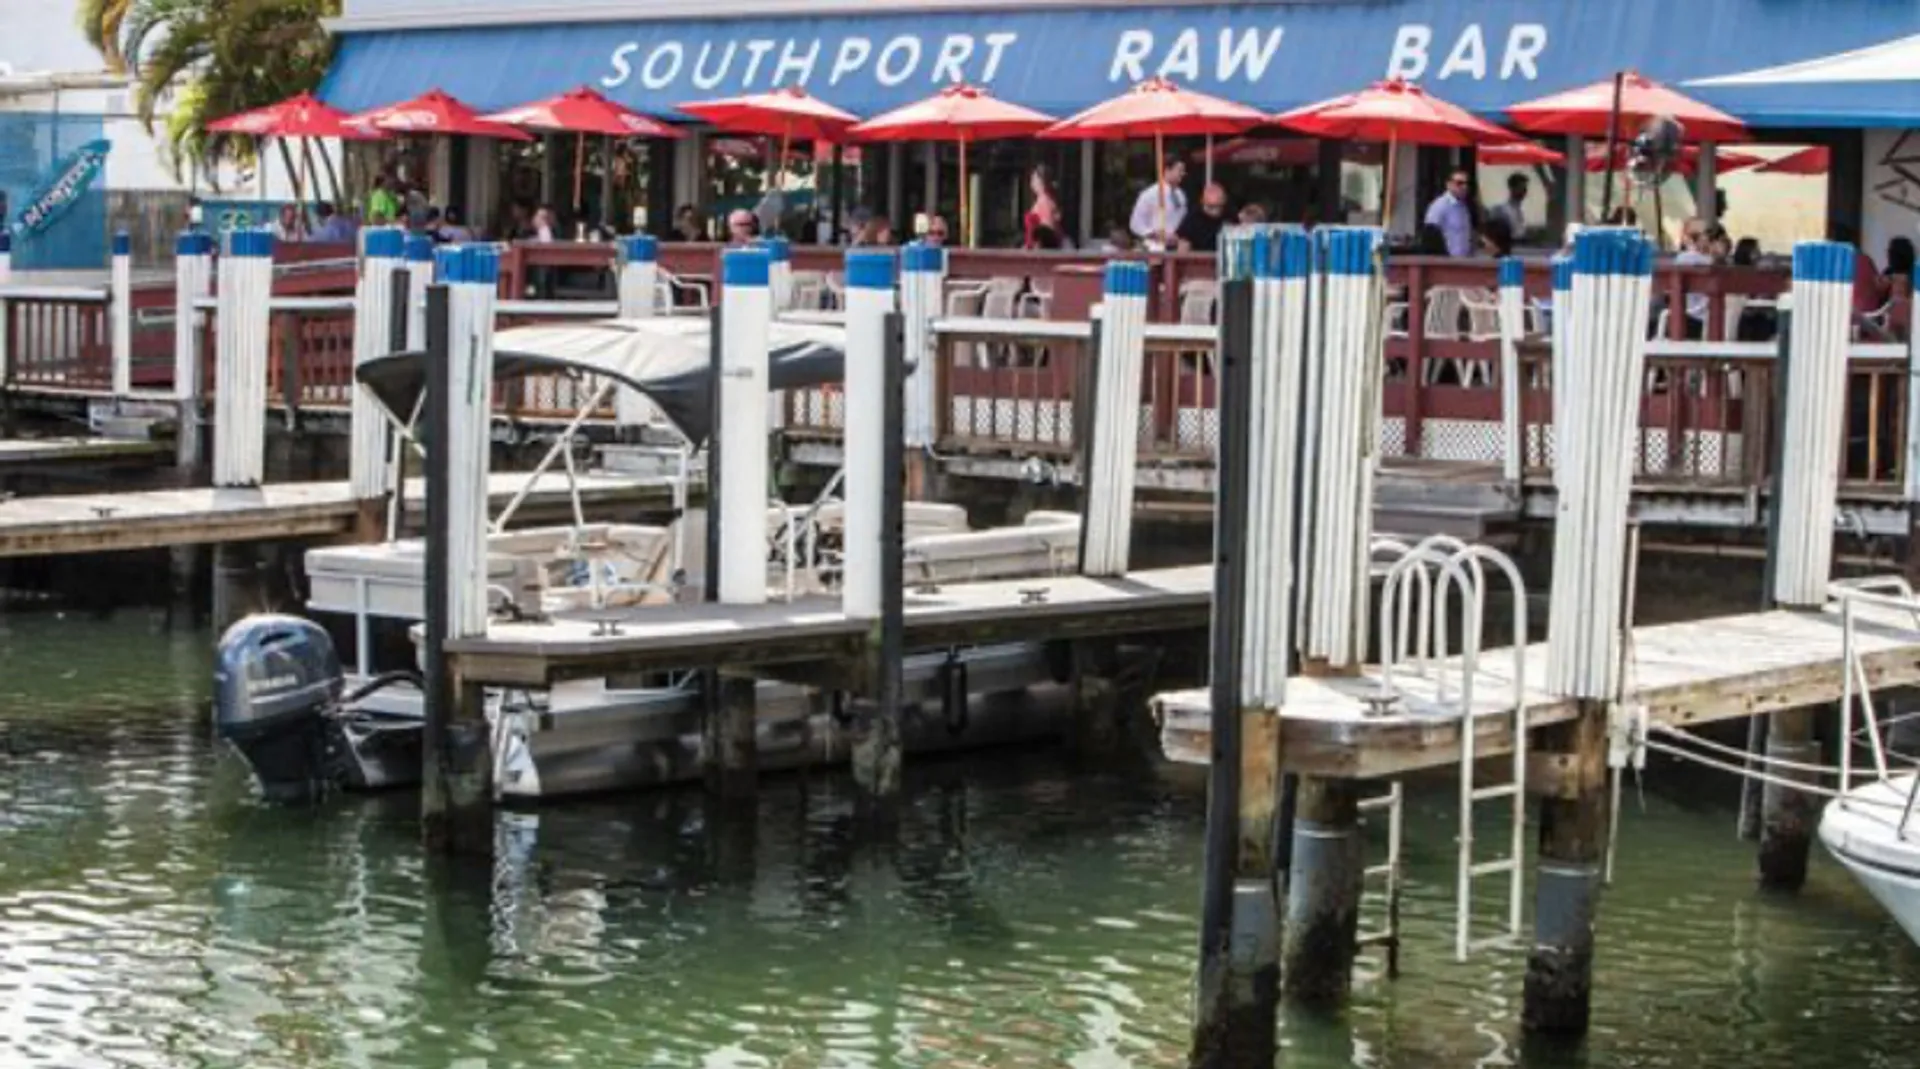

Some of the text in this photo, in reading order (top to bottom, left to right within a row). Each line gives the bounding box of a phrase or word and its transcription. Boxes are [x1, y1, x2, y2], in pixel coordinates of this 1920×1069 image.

[602, 24, 1546, 88] SOUTHPORT RAW BAR
